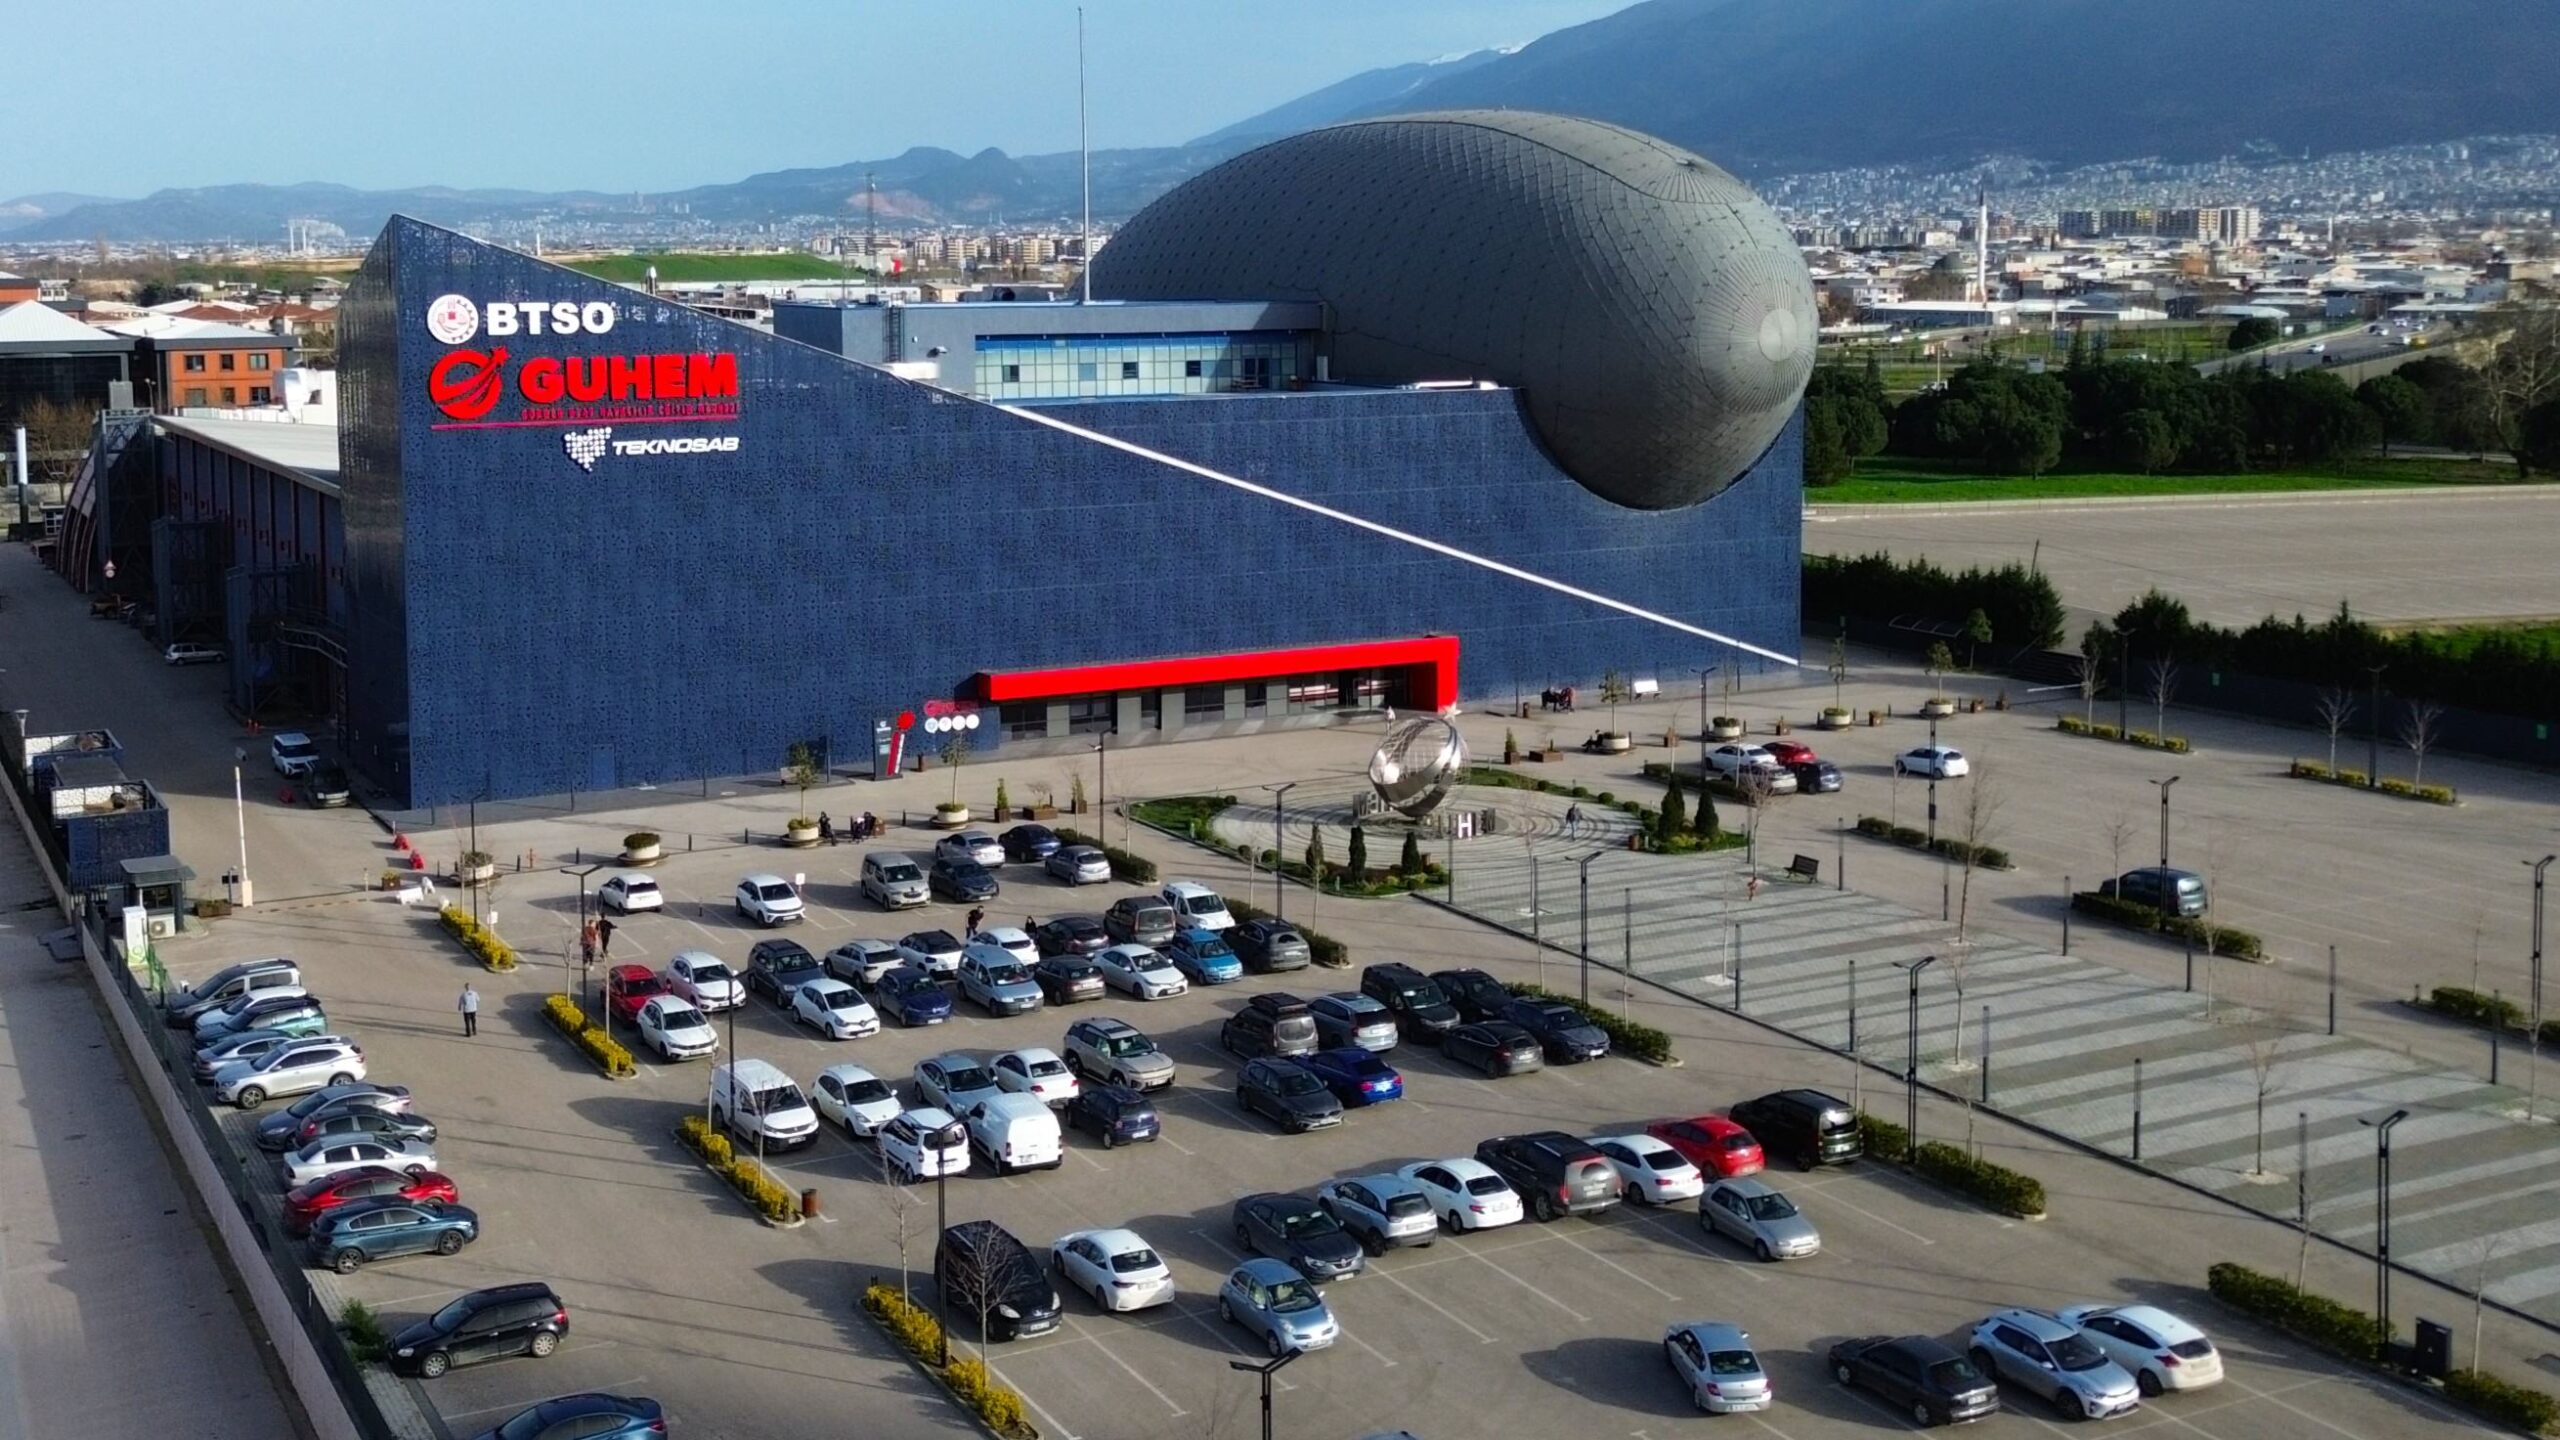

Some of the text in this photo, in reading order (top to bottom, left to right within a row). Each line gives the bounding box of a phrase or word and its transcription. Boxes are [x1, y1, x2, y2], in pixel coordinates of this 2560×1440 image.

[487, 302, 615, 336] BTSO
[519, 353, 738, 403] GUHEM
[612, 437, 739, 456] TEKNOSAB
